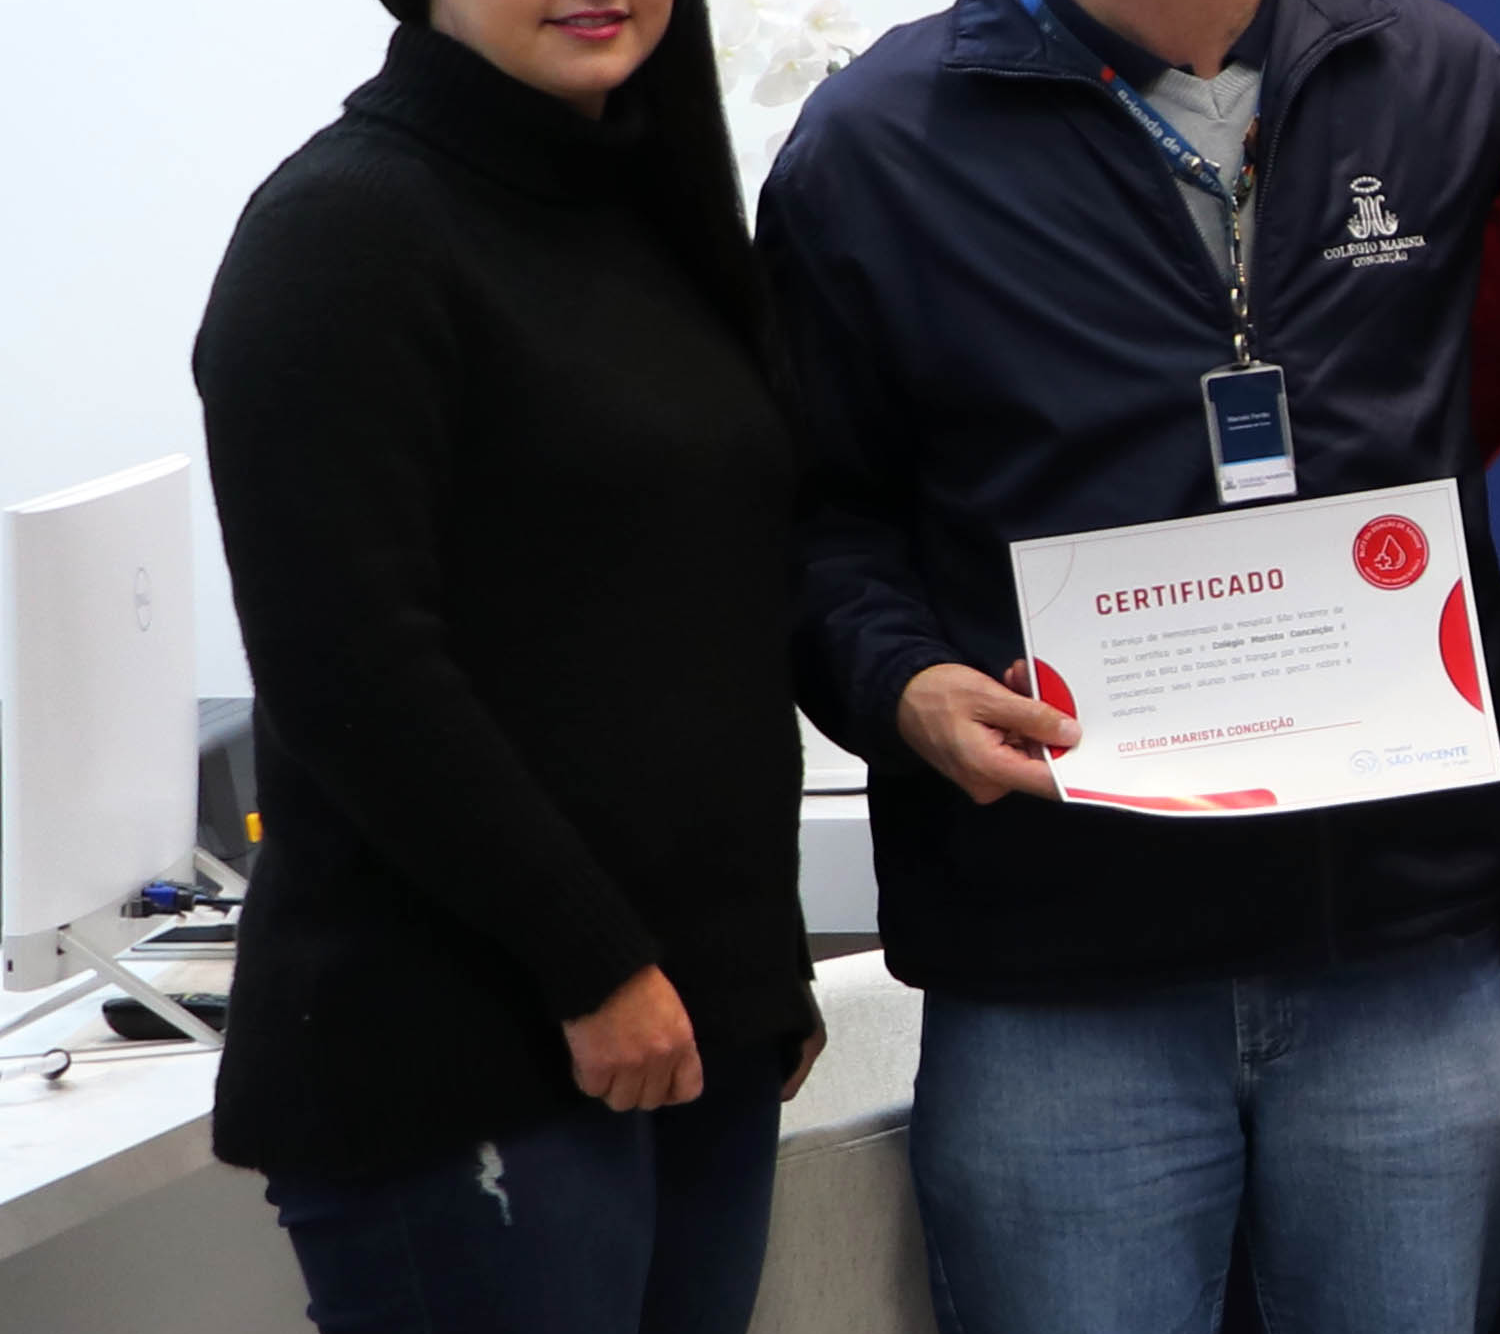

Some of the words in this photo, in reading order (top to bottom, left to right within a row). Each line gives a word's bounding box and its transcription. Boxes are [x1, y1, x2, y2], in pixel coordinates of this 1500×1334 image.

[1096, 568, 1284, 616] CERTIFICADO
[1118, 736, 1168, 753] COLÉGIO
[1171, 727, 1225, 746] MARISTA
[1227, 717, 1295, 737] CONCEIÇÃO
